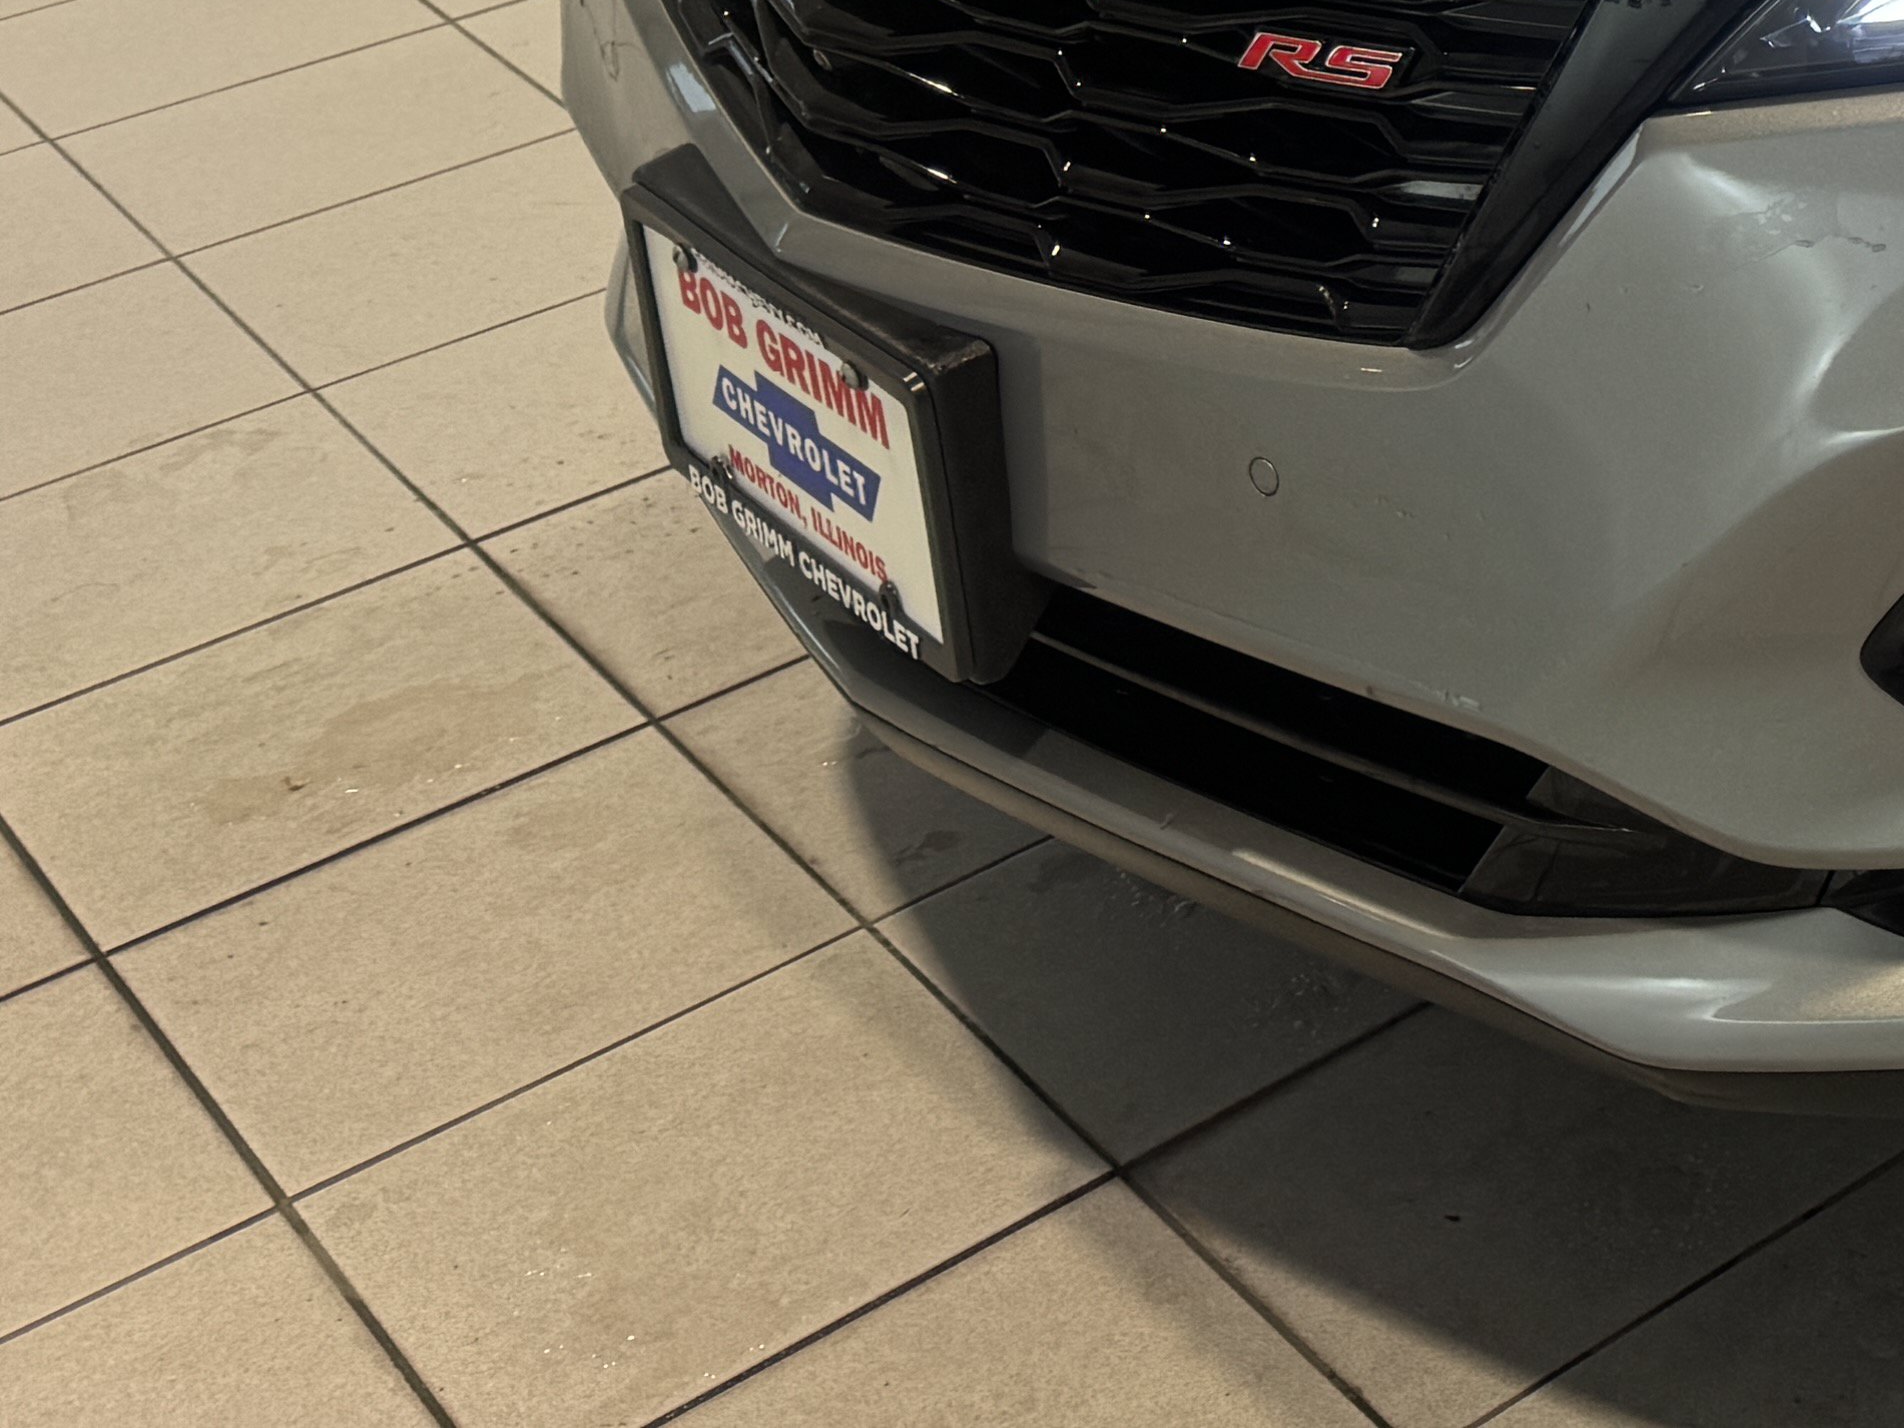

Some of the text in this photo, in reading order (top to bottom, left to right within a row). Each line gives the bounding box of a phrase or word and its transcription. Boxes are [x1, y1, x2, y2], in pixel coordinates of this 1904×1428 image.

[1238, 32, 1402, 90] RS
[679, 266, 748, 349] BOB
[757, 319, 889, 450] GRIMM
[721, 377, 866, 506] CHEVROLET
[689, 464, 920, 660] BOB GRIMM CHEVROLET
[728, 444, 888, 584] MORTON, ILLINOIS
